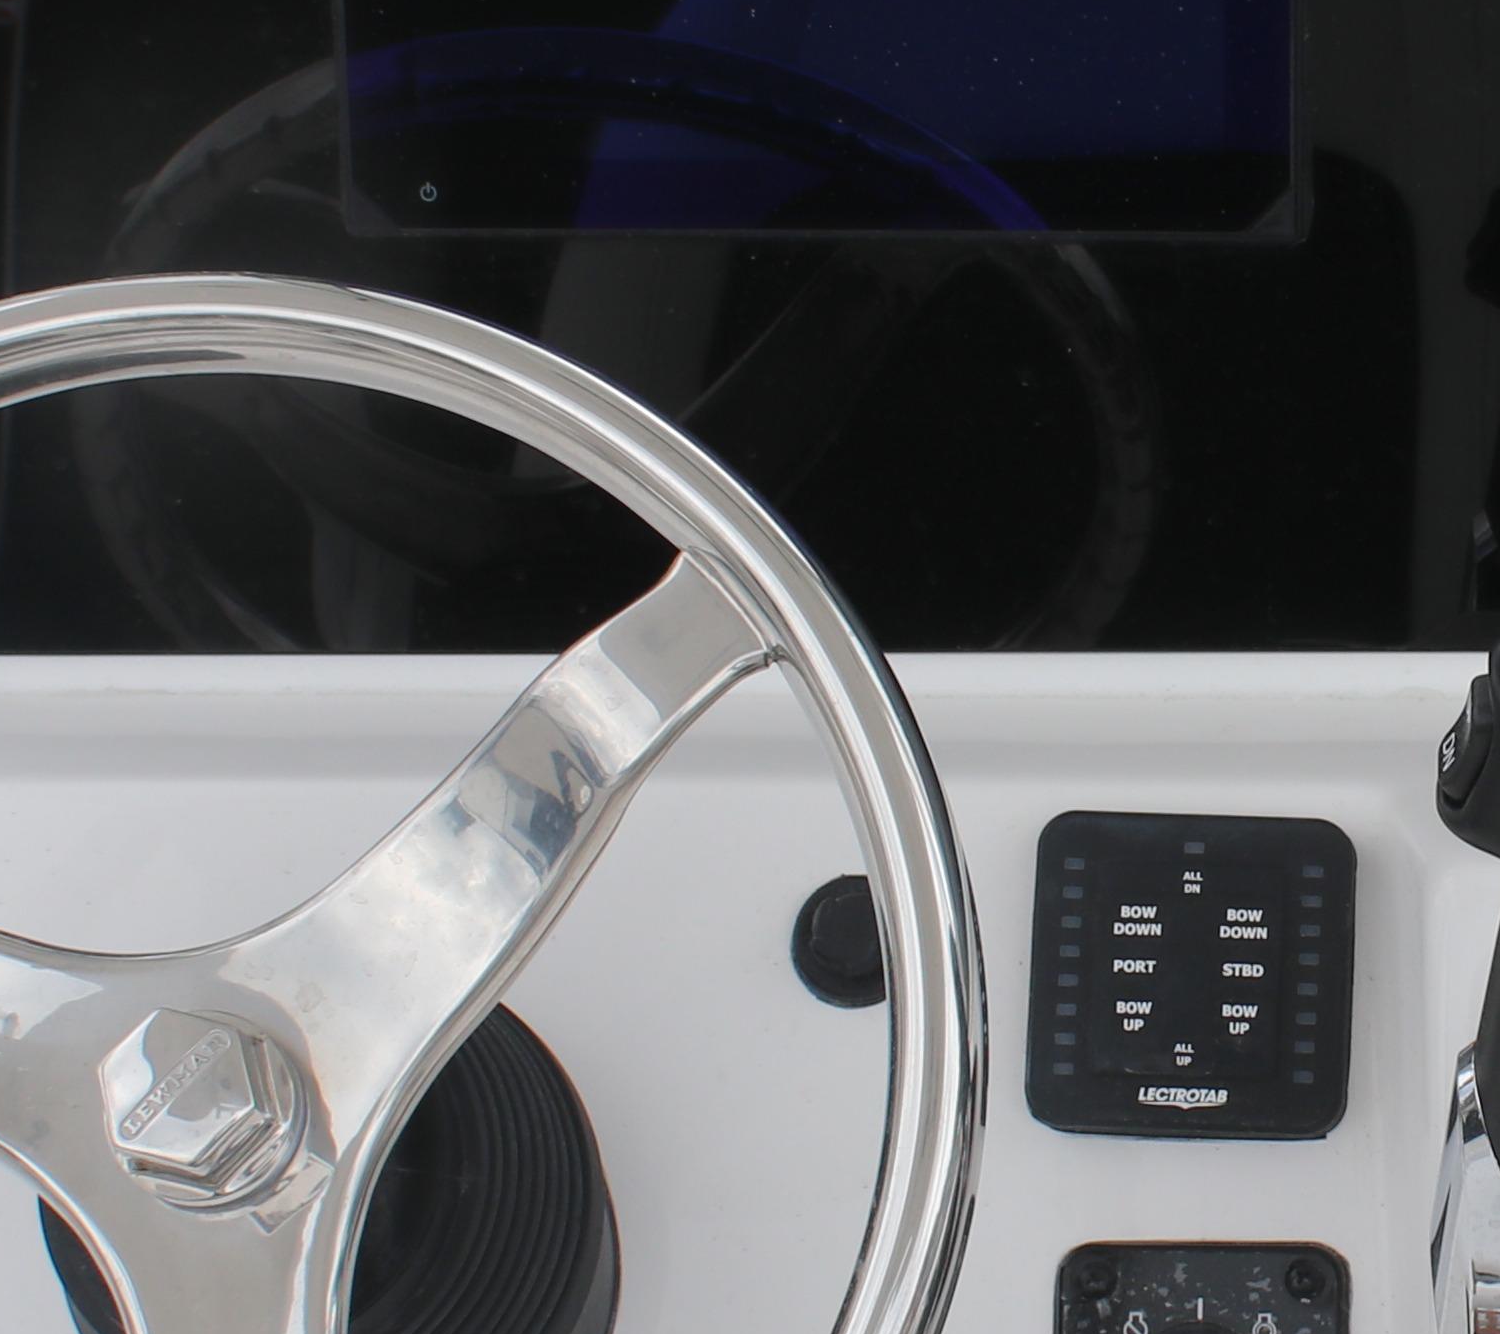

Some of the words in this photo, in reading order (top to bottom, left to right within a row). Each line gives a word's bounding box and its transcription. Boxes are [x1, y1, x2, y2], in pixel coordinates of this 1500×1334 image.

[1183, 871, 1203, 881] ALL
[1184, 884, 1200, 894] DN
[1120, 905, 1157, 919] BOW
[1226, 909, 1263, 923] BOW
[1113, 923, 1162, 936] DOWN
[1219, 926, 1268, 940] DOWN
[1113, 960, 1156, 974] PORT
[1222, 963, 1264, 977] STBD
[1116, 1001, 1152, 1015] BOW
[1221, 1004, 1259, 1018] BOW
[1123, 1019, 1144, 1032] UP
[1229, 1022, 1250, 1035] UP
[1174, 1043, 1194, 1054] ALL
[1176, 1056, 1191, 1067] UP
[1138, 1087, 1228, 1104] LECTROTAB
